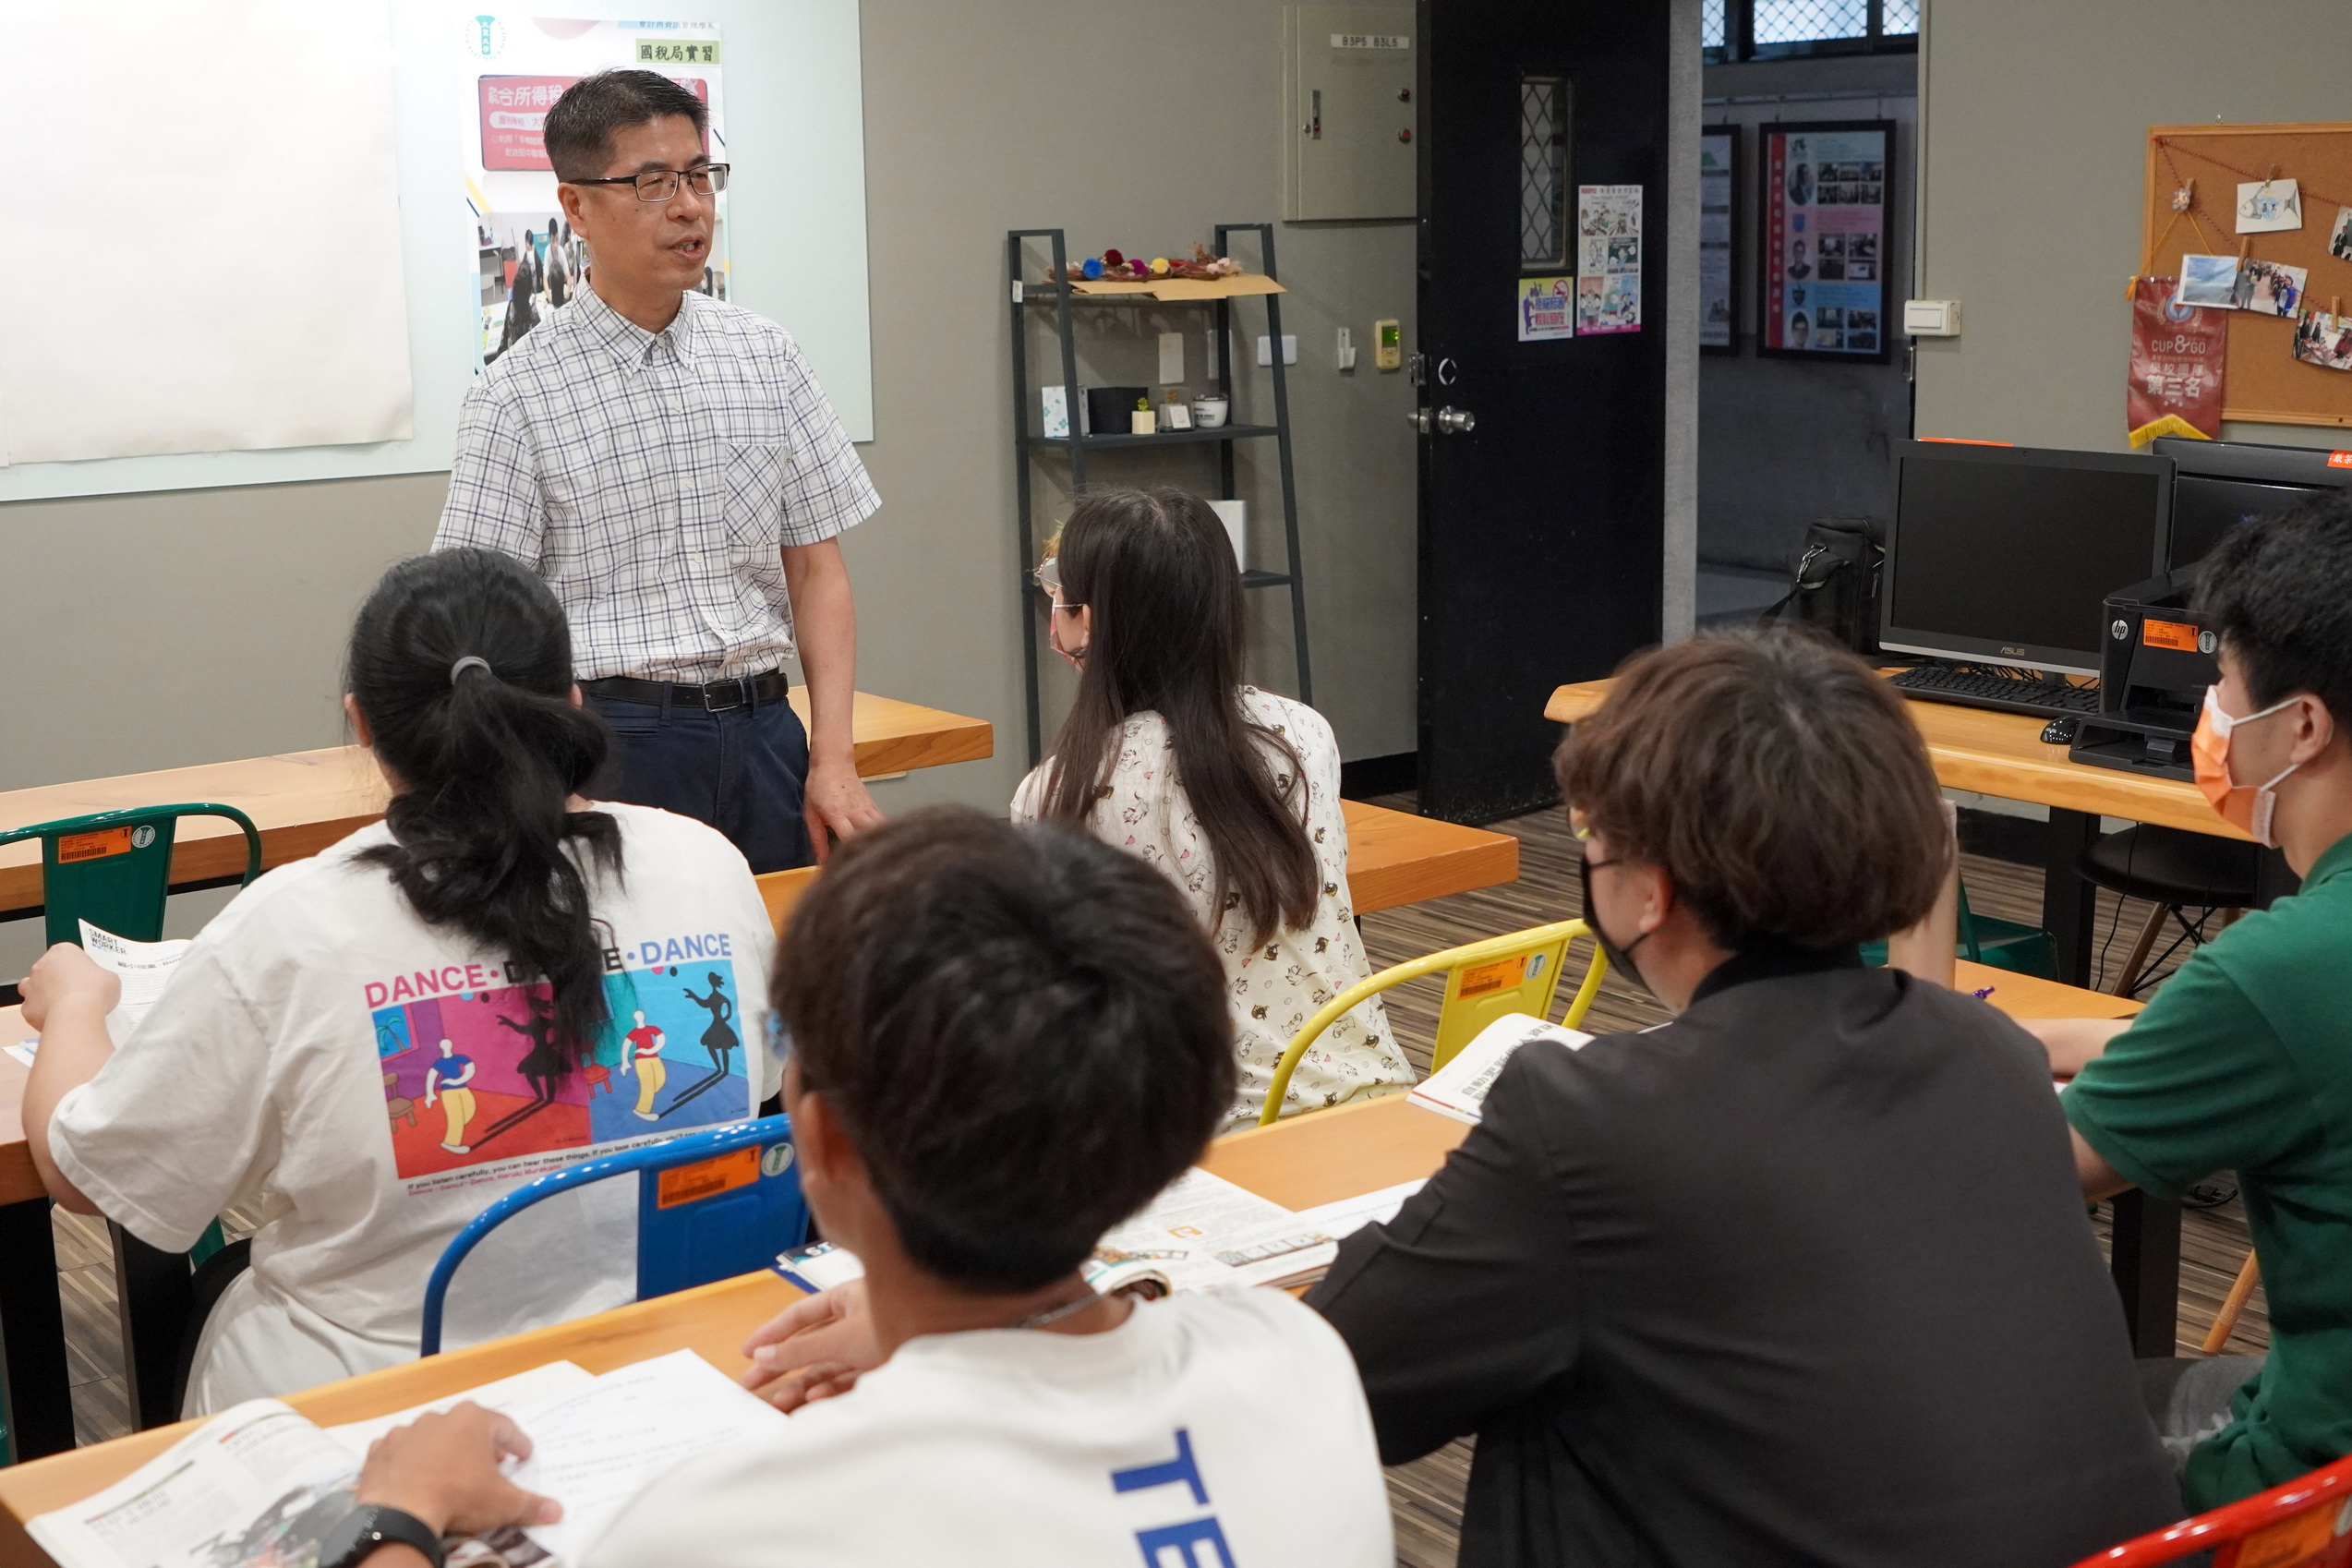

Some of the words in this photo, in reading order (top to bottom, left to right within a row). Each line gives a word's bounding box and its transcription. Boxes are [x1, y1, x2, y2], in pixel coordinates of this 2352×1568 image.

[640, 44, 713, 62] 國稅局實習
[2147, 374, 2201, 398] 第三名
[2114, 621, 2127, 639] hp
[2000, 646, 2025, 656] ASUS
[89, 928, 118, 946] SMART
[90, 937, 127, 955] WORKER
[365, 964, 488, 1009] DANCE
[640, 934, 732, 965] DANCE
[416, 1181, 431, 1189] you
[492, 1165, 507, 1174] you
[524, 1159, 540, 1168] hear
[542, 1155, 564, 1164] these
[566, 1151, 591, 1162] things.
[599, 1147, 613, 1156] you
[614, 1142, 630, 1152] look
